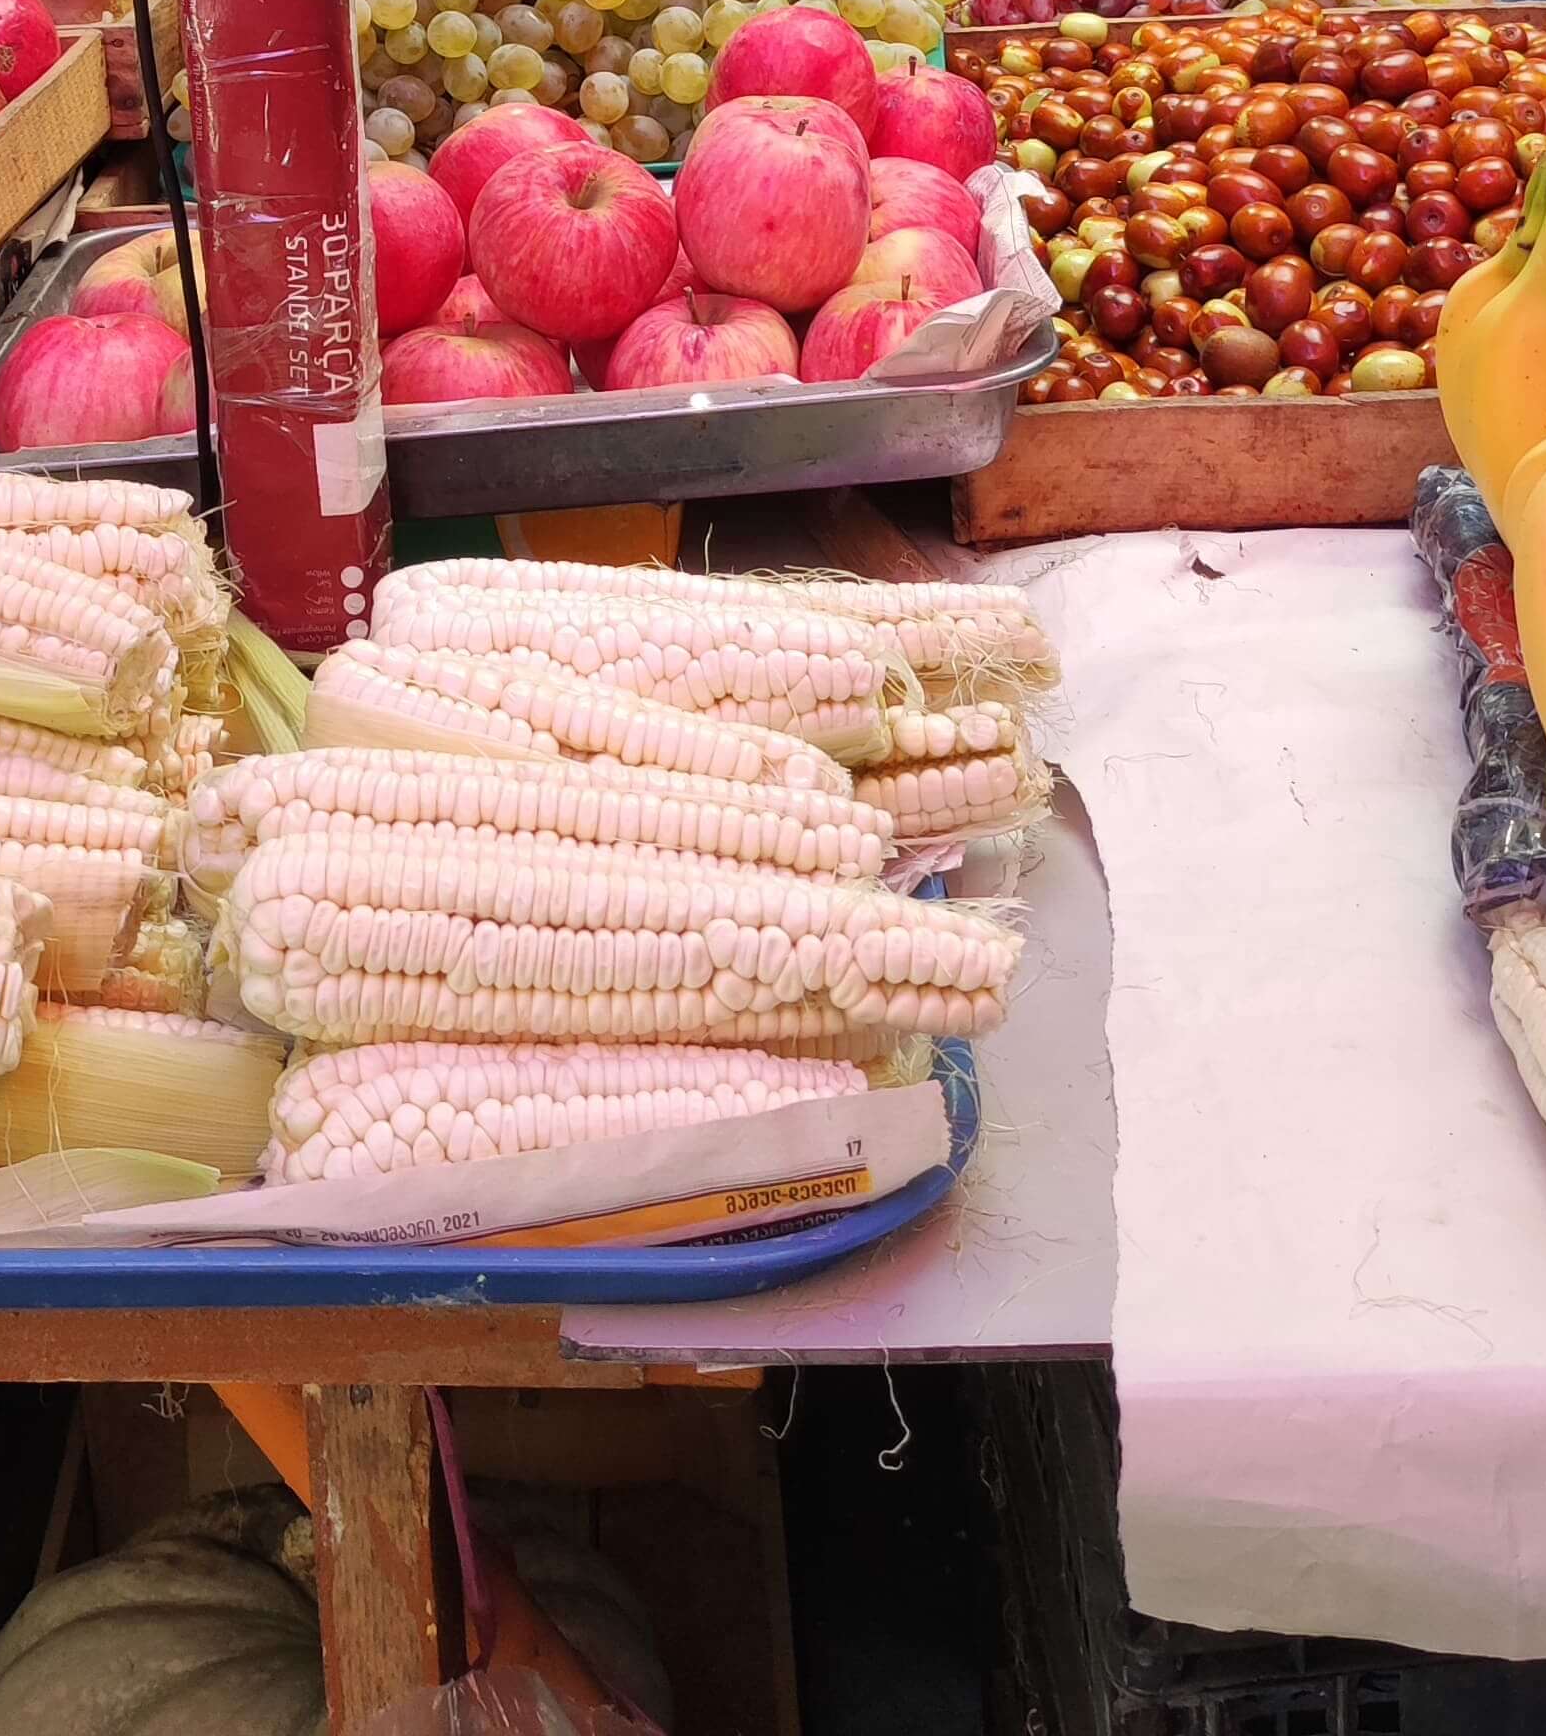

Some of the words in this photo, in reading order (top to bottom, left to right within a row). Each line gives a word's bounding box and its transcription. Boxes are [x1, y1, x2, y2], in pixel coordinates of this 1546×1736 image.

[321, 210, 350, 258] 30
[313, 268, 354, 396] PARÇA
[288, 349, 310, 397] SET
[845, 1139, 862, 1158] 17
[724, 1176, 857, 1214] მამულ-დედული
[443, 1210, 480, 1233] 2021
